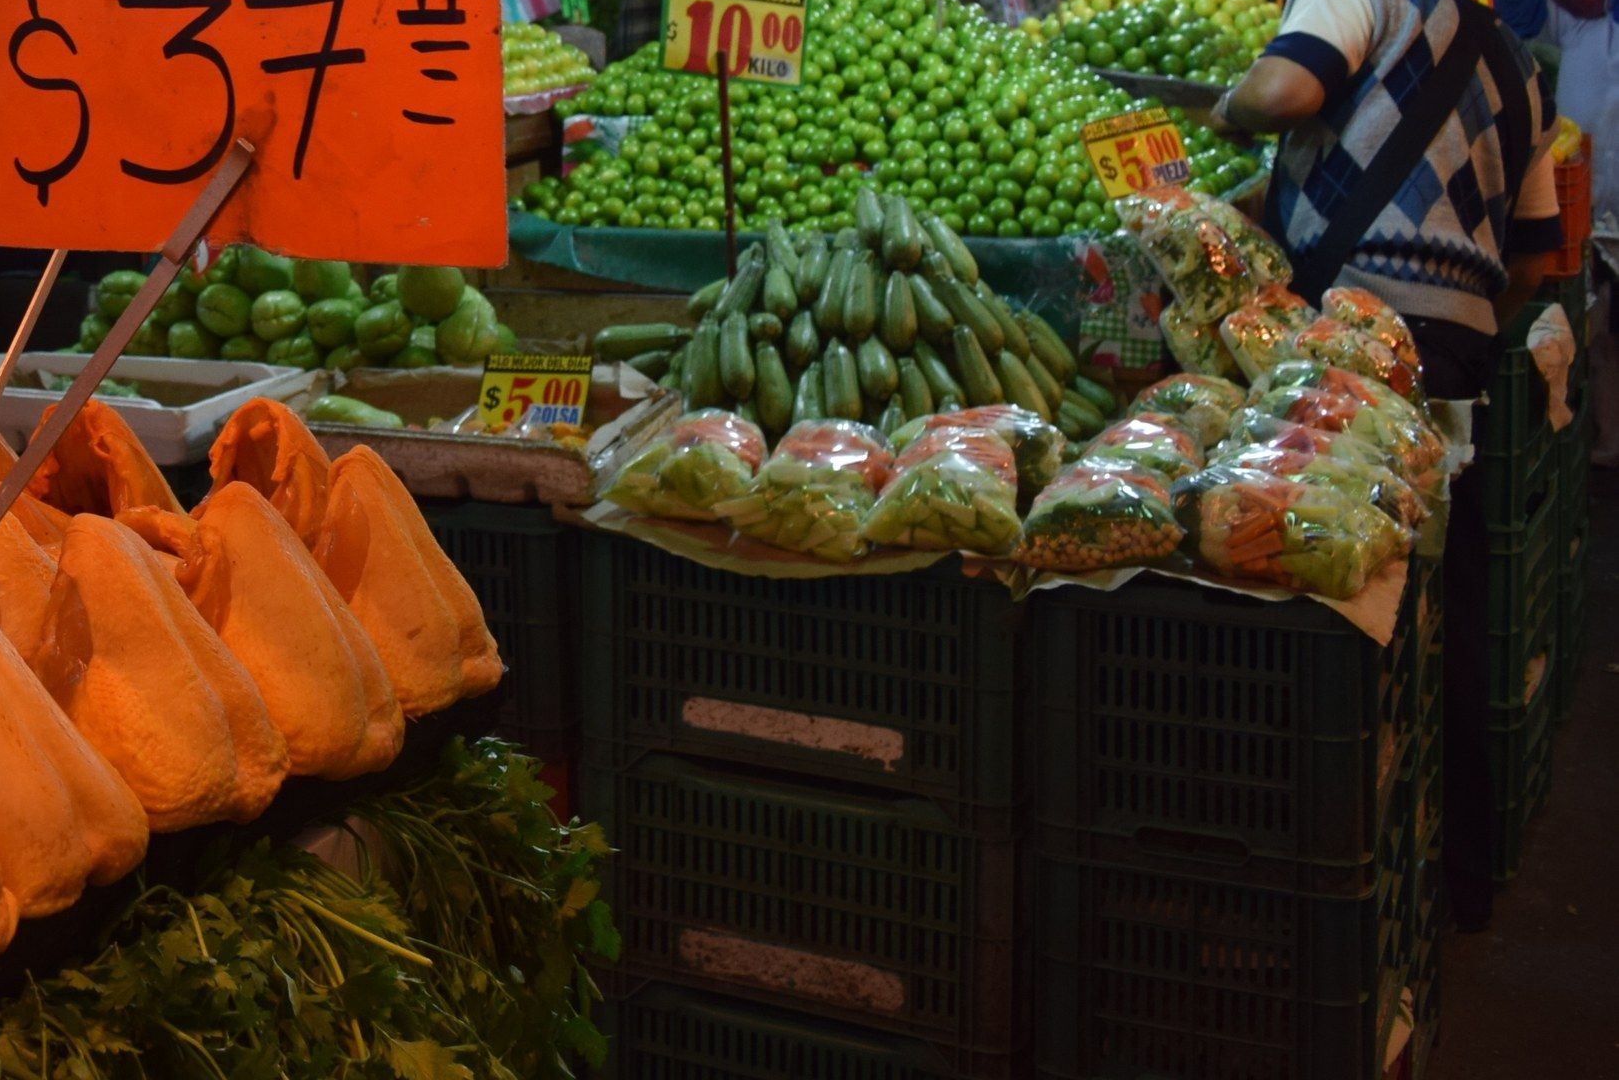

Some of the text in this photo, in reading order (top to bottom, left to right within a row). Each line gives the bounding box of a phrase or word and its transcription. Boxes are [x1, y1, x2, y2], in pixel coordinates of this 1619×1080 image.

[683, 0, 753, 77] 10
[762, 11, 802, 53] 00
[748, 56, 788, 78] KILO
[1099, 129, 1179, 192] $ 5 00
[483, 376, 581, 422] $ 5 00
